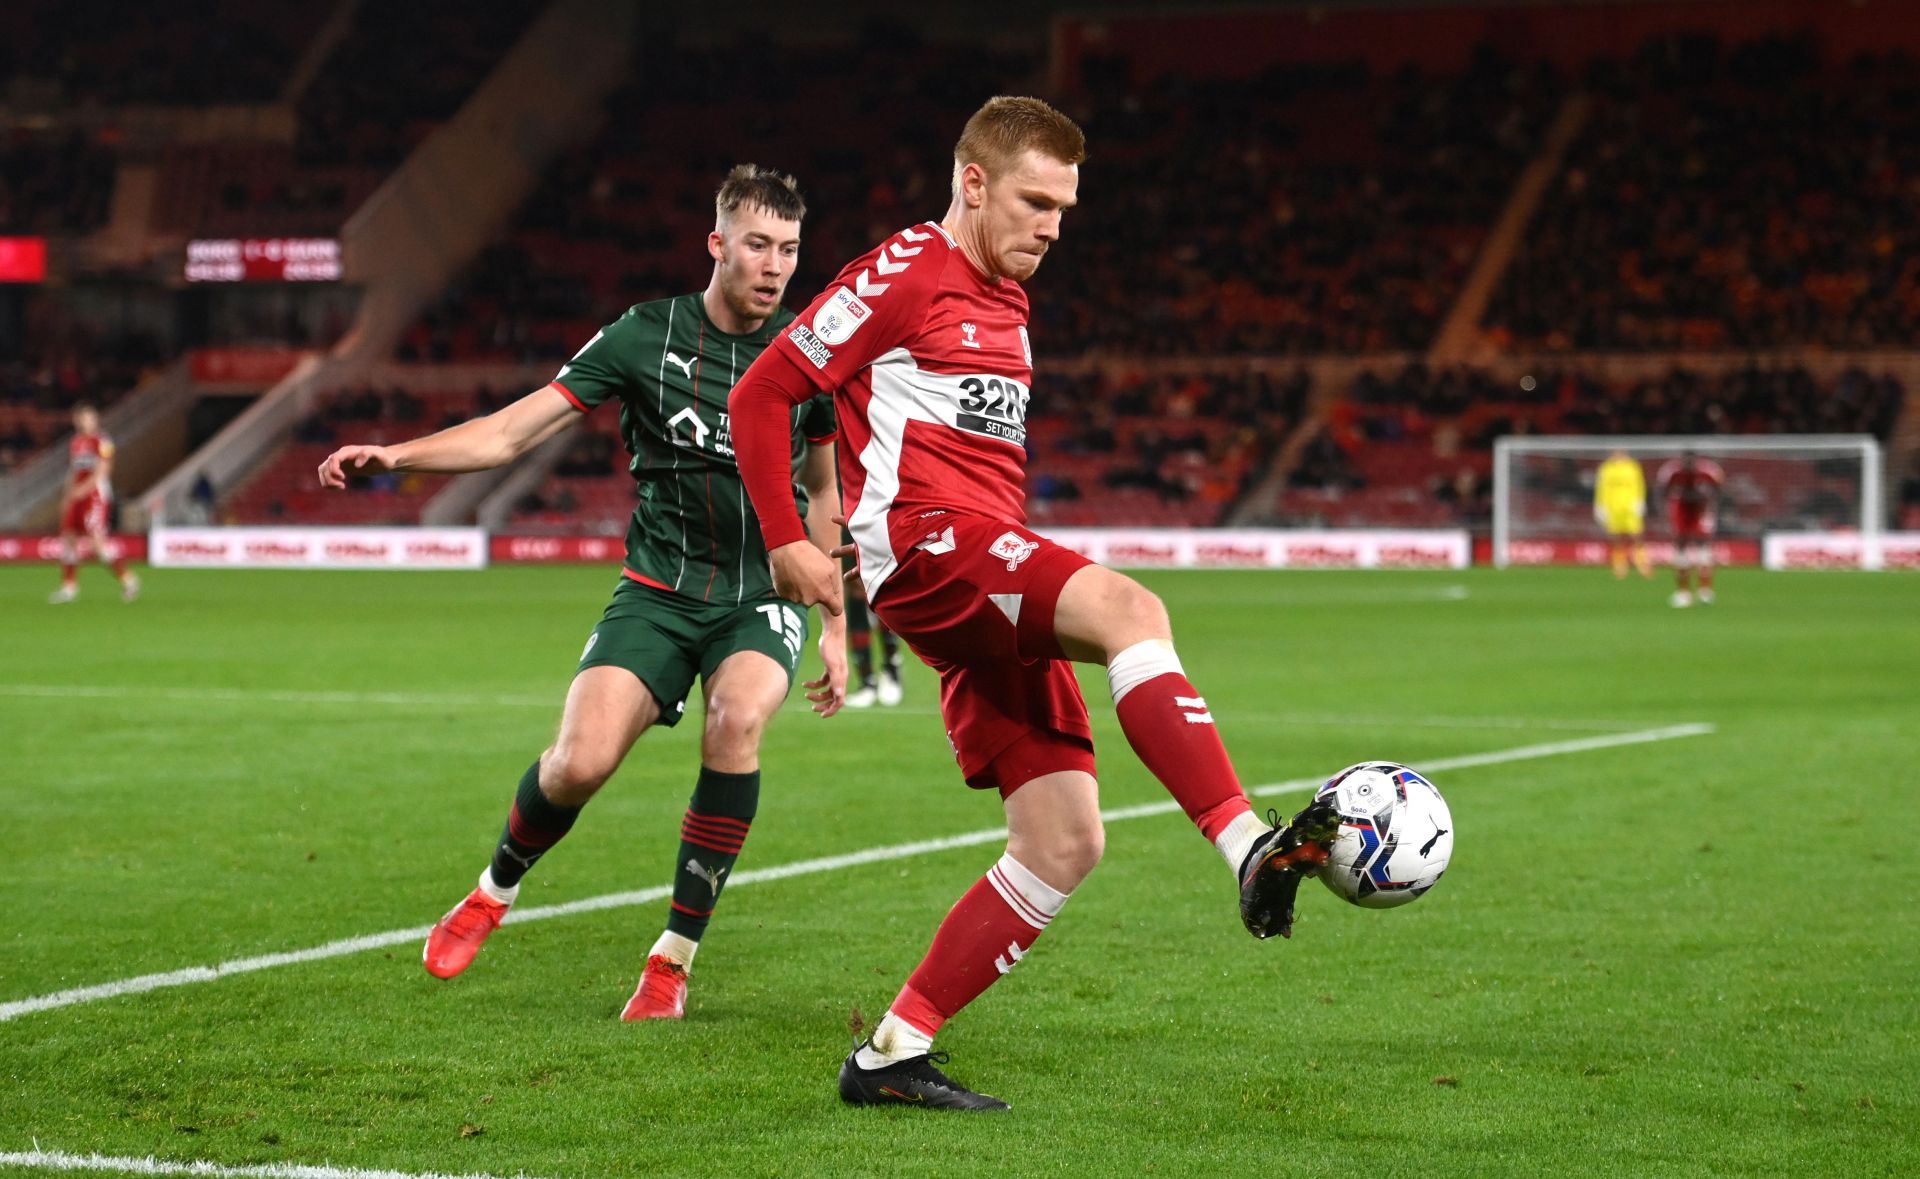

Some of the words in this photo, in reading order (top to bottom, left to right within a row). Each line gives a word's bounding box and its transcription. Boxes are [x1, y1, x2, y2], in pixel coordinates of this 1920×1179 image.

[838, 294, 849, 304] sky
[849, 303, 863, 316] bet
[790, 331, 800, 341] OR
[797, 339, 813, 353] ANY
[810, 352, 825, 366] DAY
[796, 323, 813, 338] NOT
[809, 335, 833, 360] TODAY
[820, 326, 832, 338] EFL
[959, 377, 1027, 423] 32R
[985, 421, 1001, 434] SET
[1002, 426, 1017, 440] YOUR
[755, 603, 802, 652] 15
